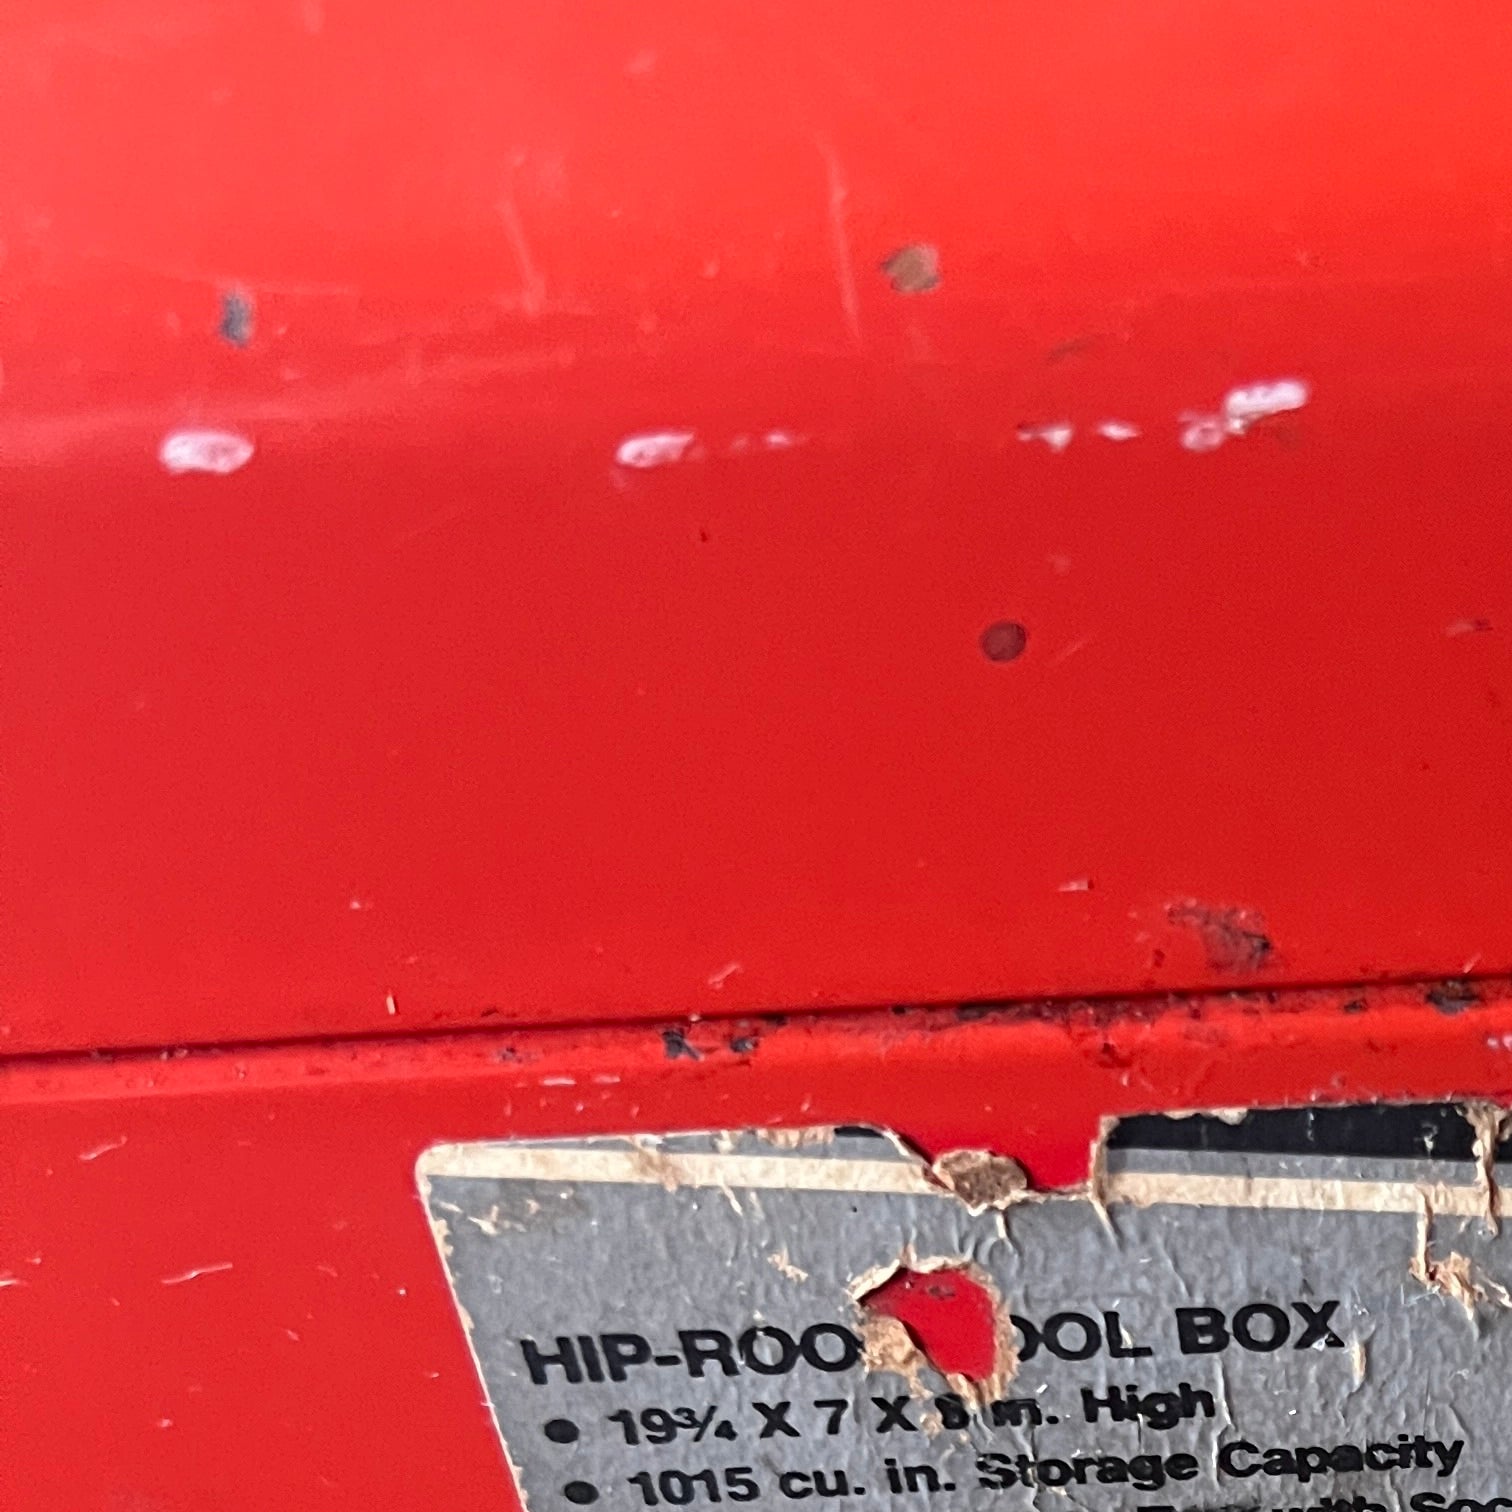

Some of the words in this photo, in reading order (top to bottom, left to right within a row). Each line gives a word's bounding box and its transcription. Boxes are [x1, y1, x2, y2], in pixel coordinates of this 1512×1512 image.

[520, 1322, 865, 1386] HIP-ROO
[1175, 1300, 1346, 1355] BOX
[752, 1401, 801, 1439] X
[814, 1400, 849, 1435] 7
[871, 1395, 918, 1434] X
[1080, 1382, 1216, 1430] High
[628, 1466, 762, 1506] 1015
[779, 1467, 867, 1500] cu.
[884, 1458, 957, 1494] in.
[976, 1450, 1199, 1491] Storage
[1218, 1434, 1465, 1482] Capacity
